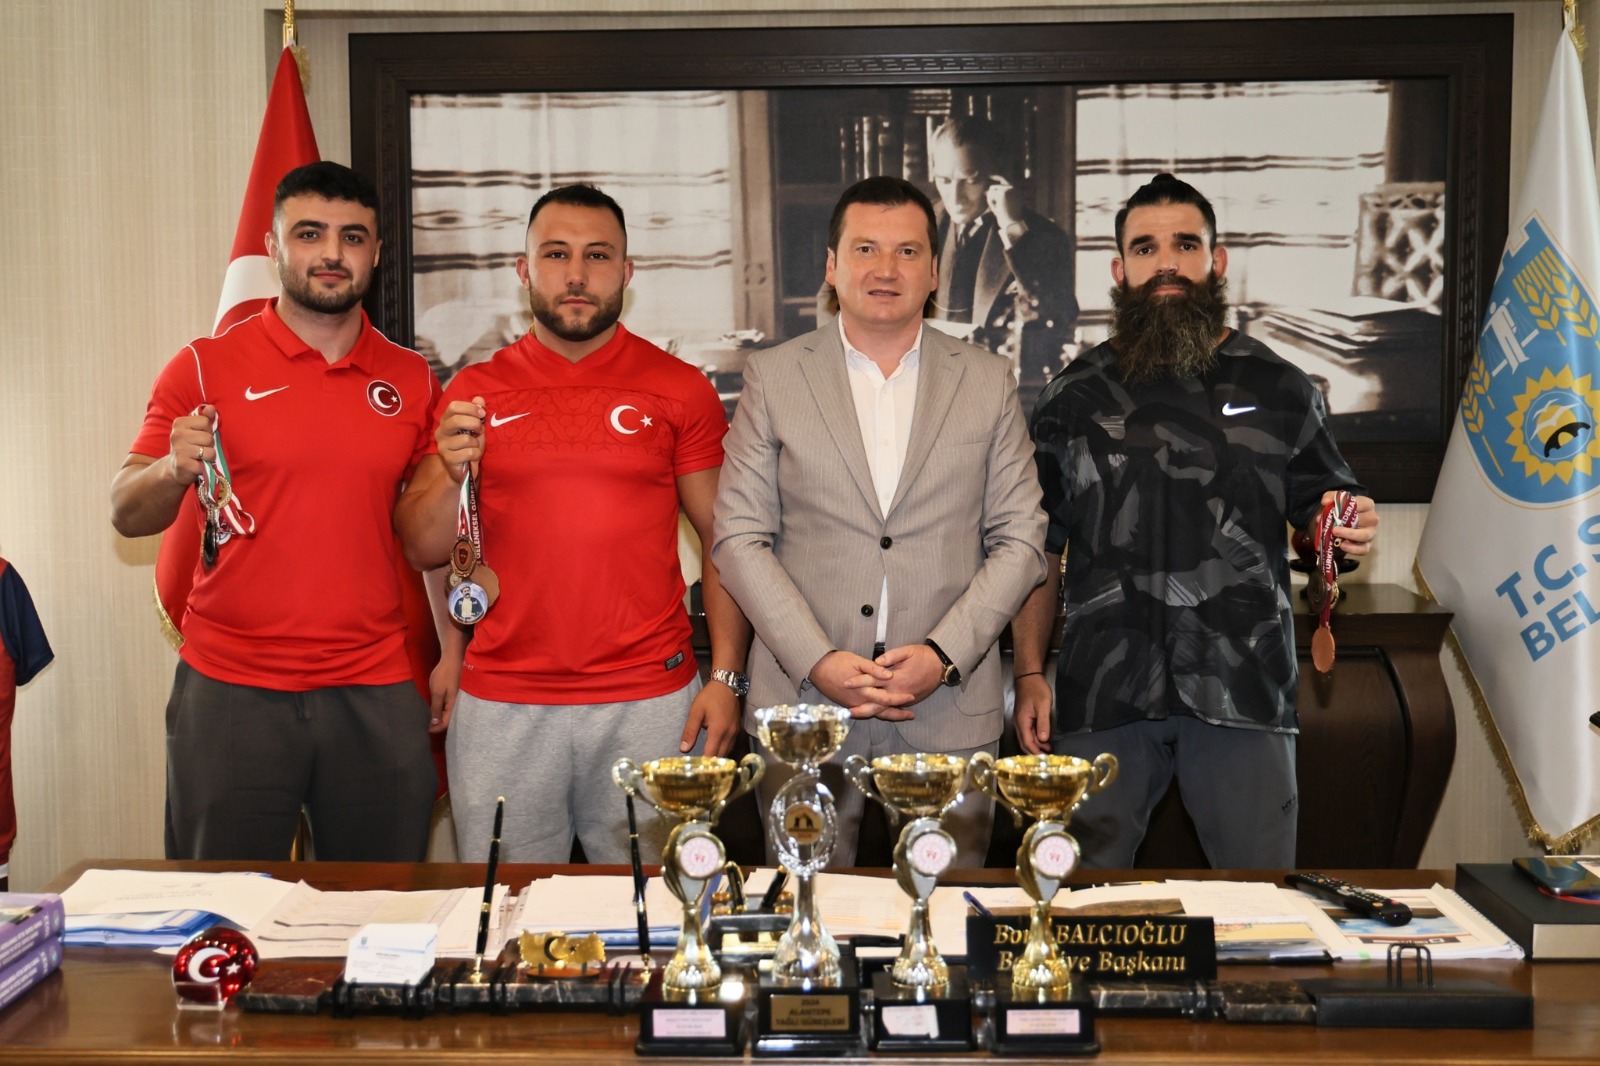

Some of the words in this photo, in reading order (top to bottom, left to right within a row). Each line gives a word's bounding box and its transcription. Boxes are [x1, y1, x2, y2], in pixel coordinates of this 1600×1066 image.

[1495, 544, 1587, 618] T.C.
[1056, 920, 1187, 945] BALCIOĞLU
[1097, 951, 1186, 976] Başkanı
